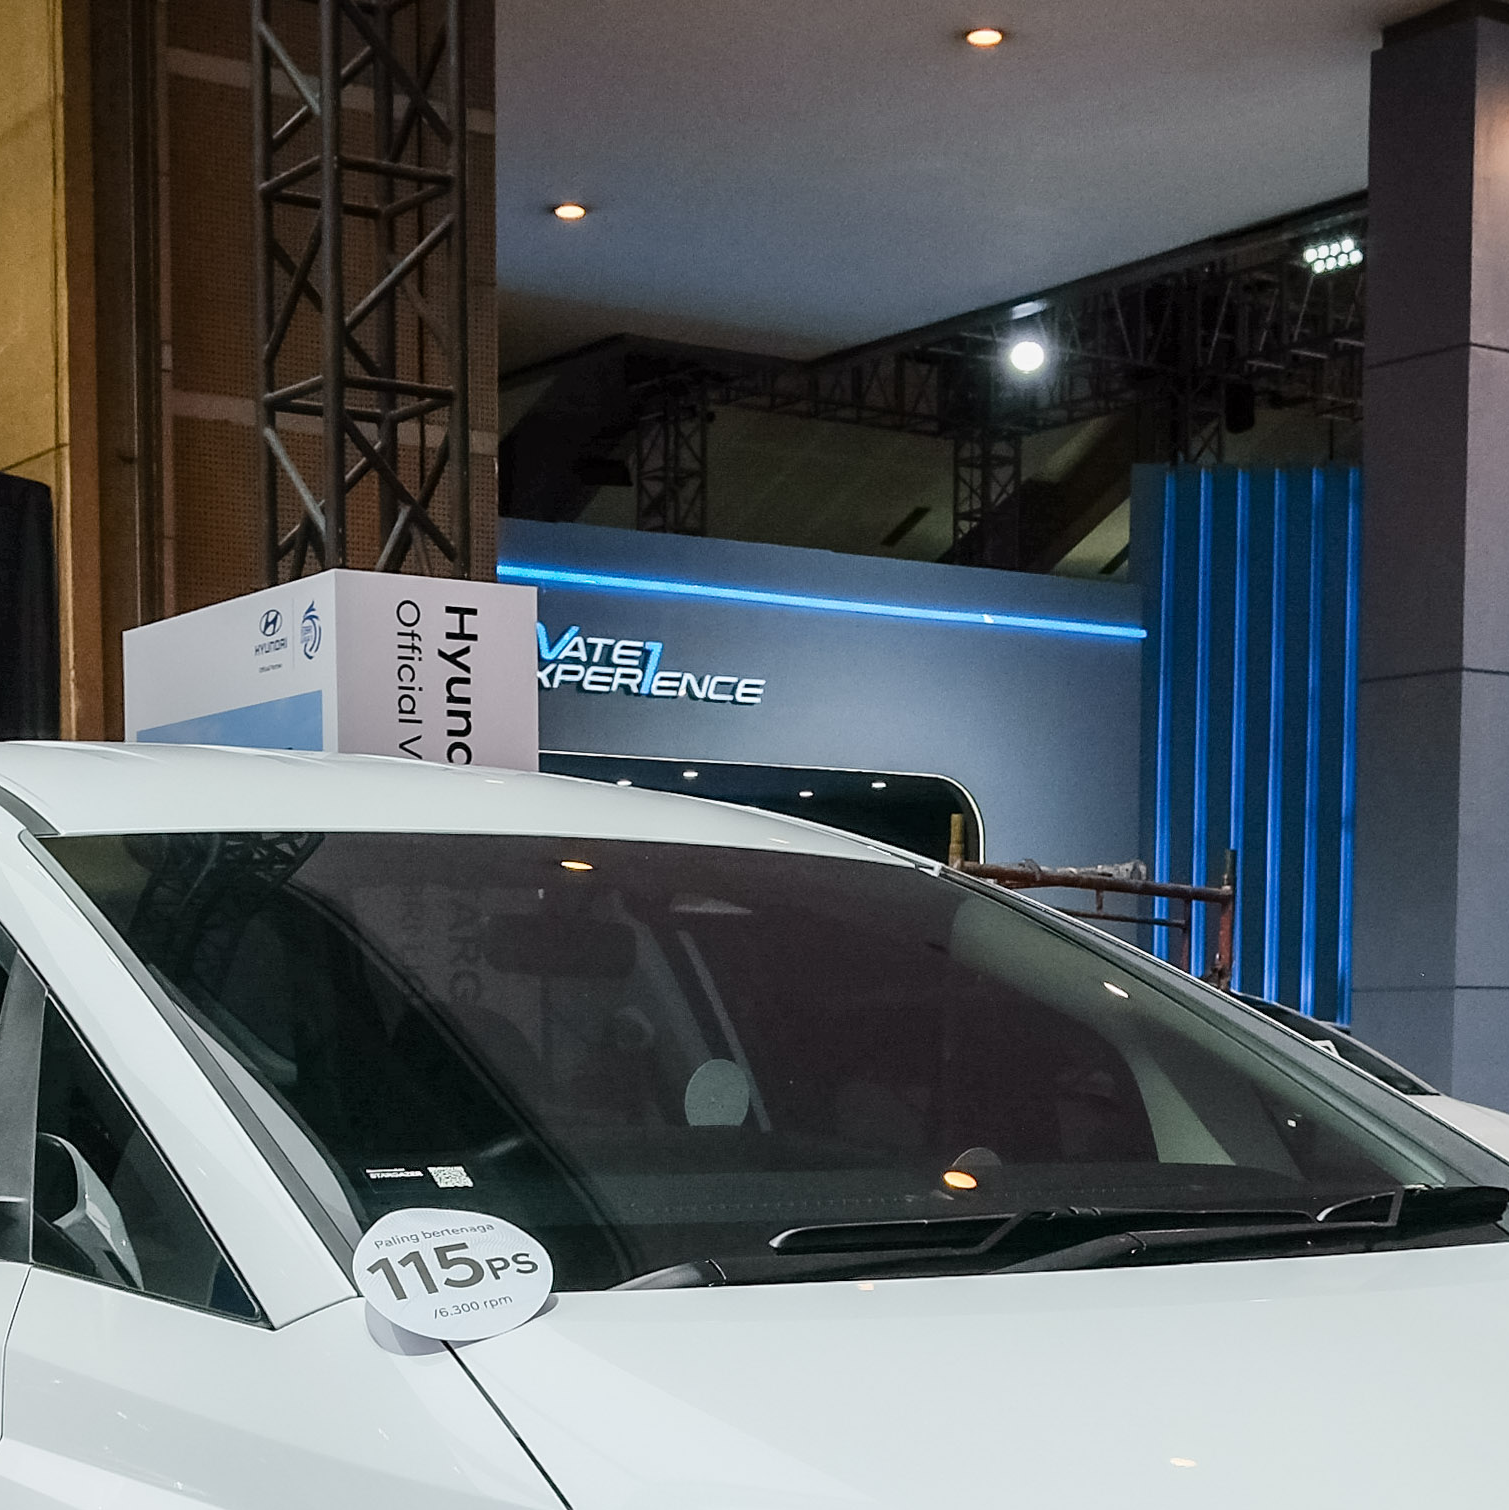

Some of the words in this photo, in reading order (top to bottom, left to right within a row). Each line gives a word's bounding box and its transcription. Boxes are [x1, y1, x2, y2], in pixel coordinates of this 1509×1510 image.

[396, 599, 424, 724] Official
[374, 1232, 420, 1250] Paling
[421, 1222, 495, 1240] bertenaga
[434, 1301, 480, 1319] /6.300
[483, 1294, 513, 1310] rpm
